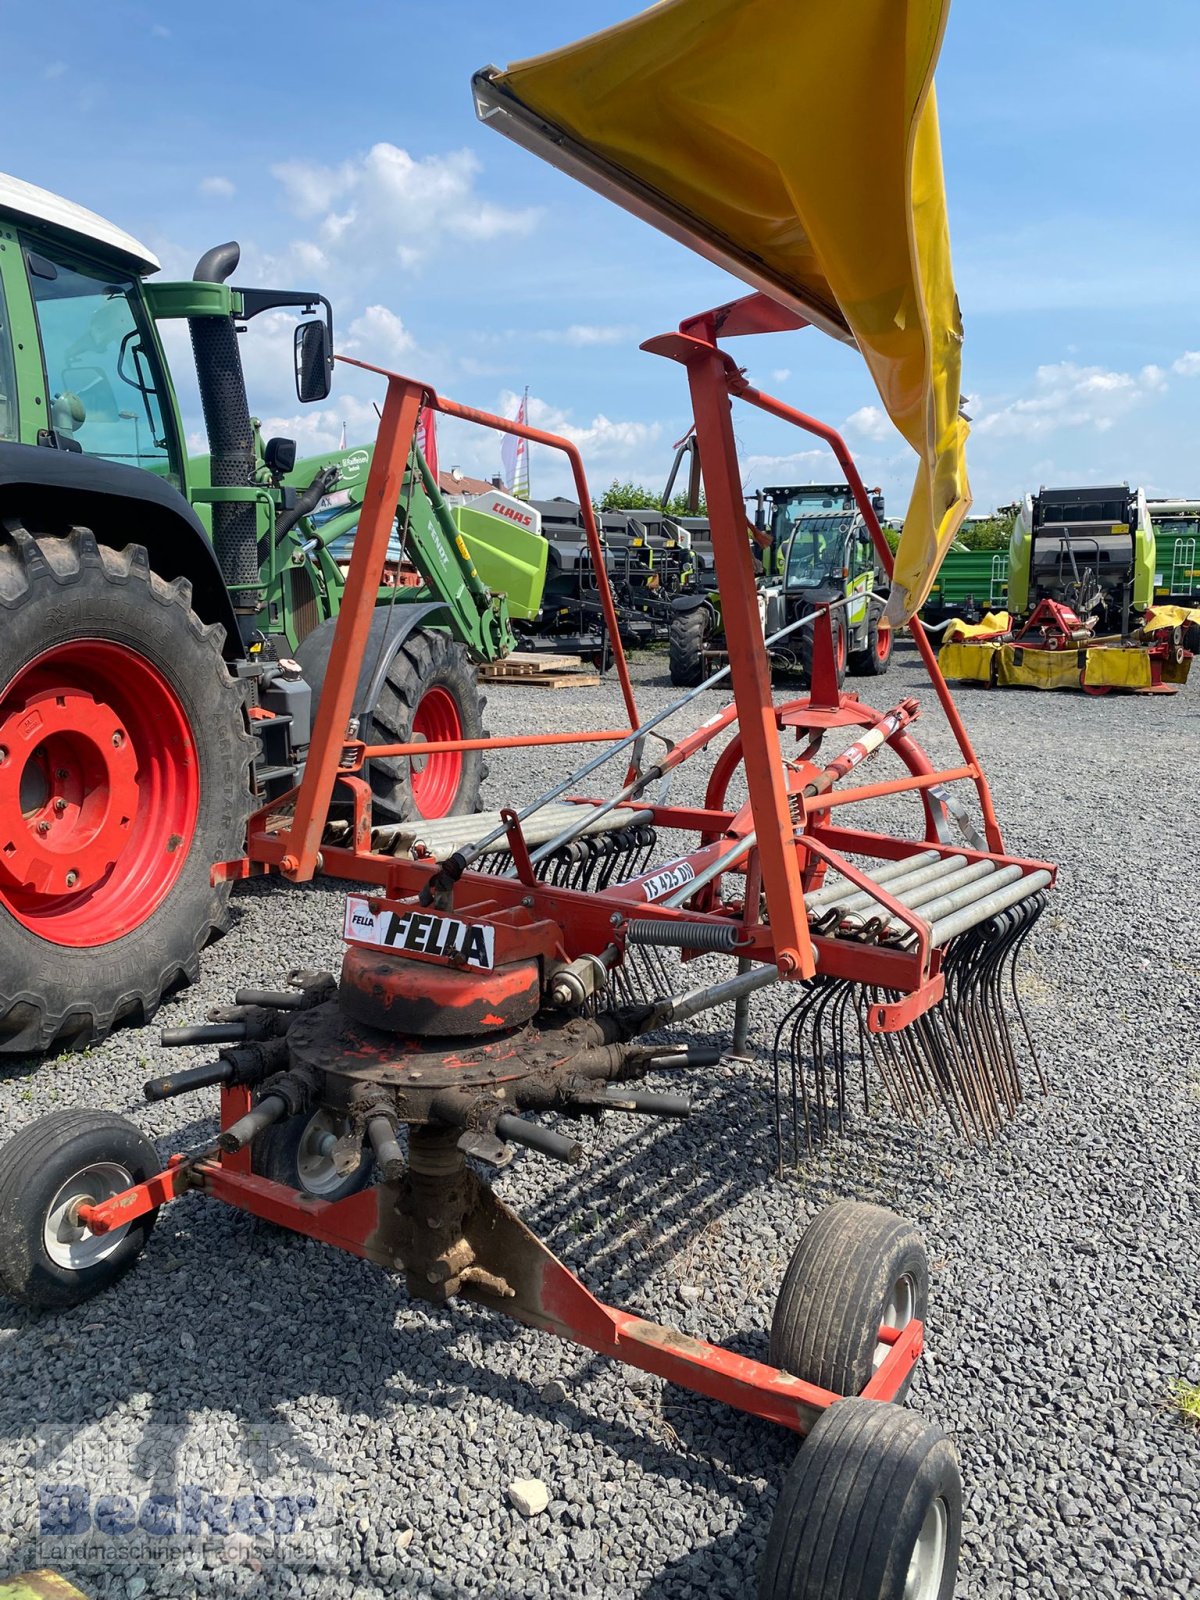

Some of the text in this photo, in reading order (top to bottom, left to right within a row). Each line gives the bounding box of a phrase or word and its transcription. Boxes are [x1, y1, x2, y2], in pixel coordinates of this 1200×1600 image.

[492, 502, 533, 527] CLAAS
[428, 520, 450, 565] FENDT
[644, 881, 659, 899] TS
[660, 872, 679, 891] 425
[677, 864, 694, 882] DN
[352, 915, 375, 928] FELLA
[384, 911, 490, 968] FELLA
